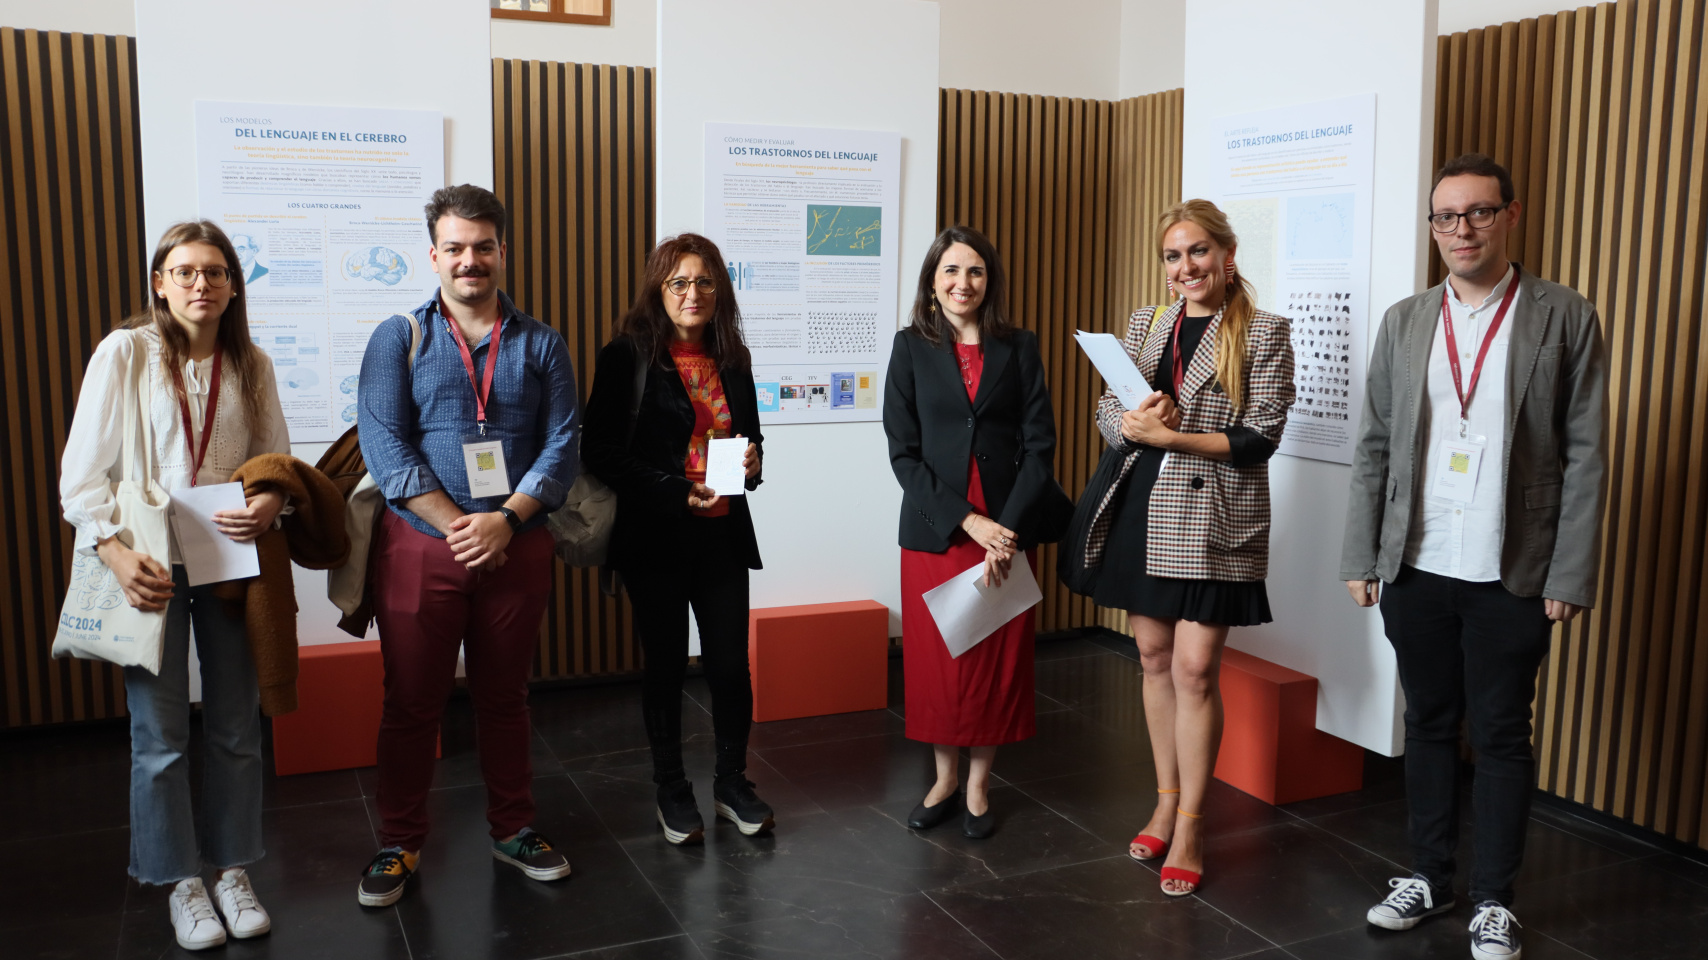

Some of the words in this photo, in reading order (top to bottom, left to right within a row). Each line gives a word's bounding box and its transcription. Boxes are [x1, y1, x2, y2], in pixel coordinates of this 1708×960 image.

[236, 117, 272, 125] MODELOS
[235, 128, 257, 138] DEL
[260, 129, 319, 142] LENGUAJE
[322, 131, 337, 141] EN
[340, 132, 352, 142] EL
[355, 133, 407, 144] CEREBRO
[1227, 140, 1241, 150] LOS
[1242, 132, 1293, 148] TRASTORNOS
[1295, 130, 1309, 141] DEL
[1311, 124, 1352, 138] LENGUAJE
[729, 146, 747, 155] LOS
[749, 147, 813, 158] TRASTORNOS
[814, 150, 831, 159] DEL
[833, 151, 878, 162] LENGUAJE
[75, 617, 102, 631] 2024
